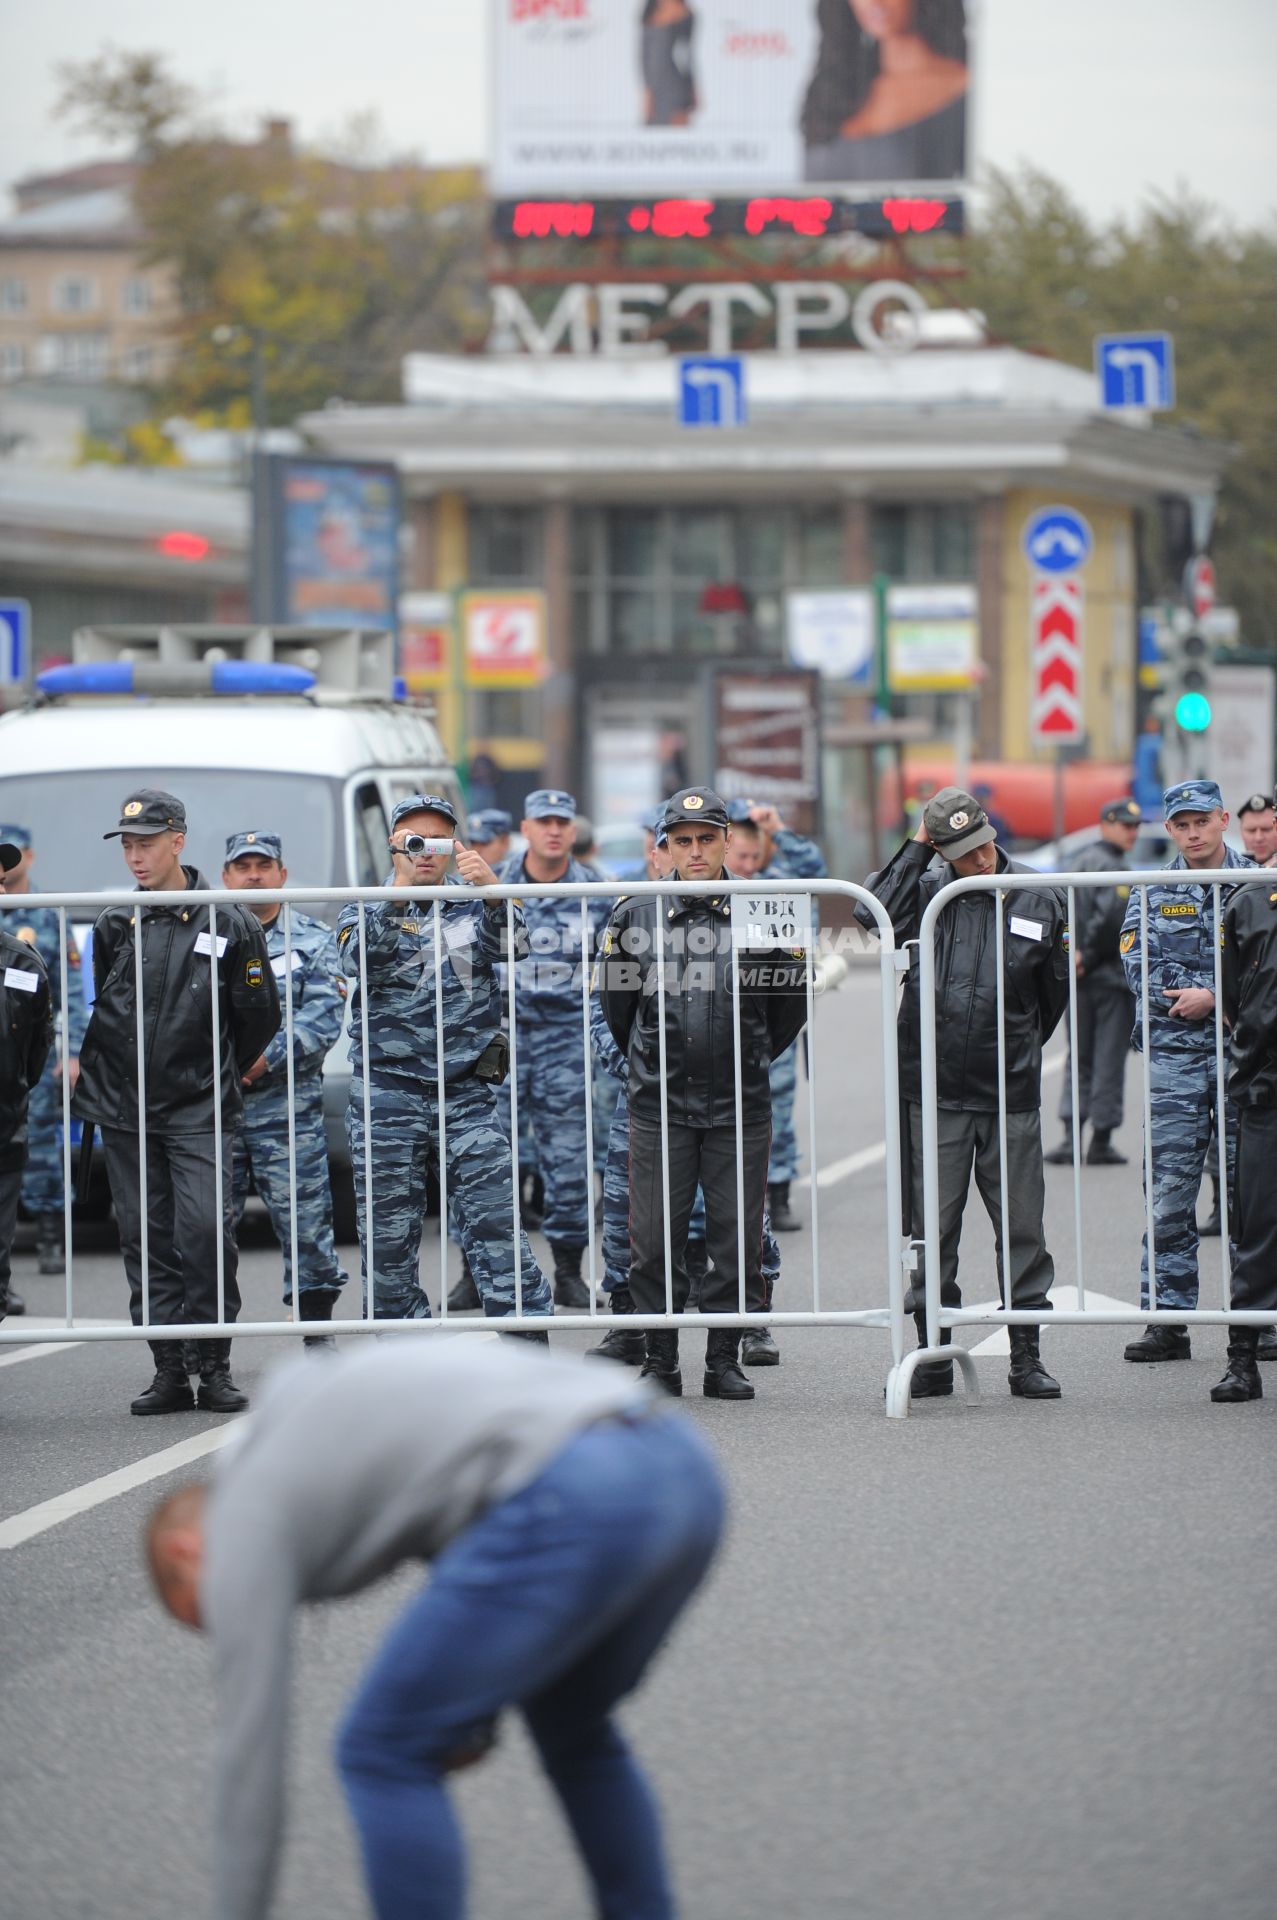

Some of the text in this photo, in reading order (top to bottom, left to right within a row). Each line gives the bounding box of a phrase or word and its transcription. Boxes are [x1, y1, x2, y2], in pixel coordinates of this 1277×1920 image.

[487, 280, 927, 356] МЕТРО
[748, 900, 796, 918] УВД
[1163, 906, 1194, 914] ОМОН
